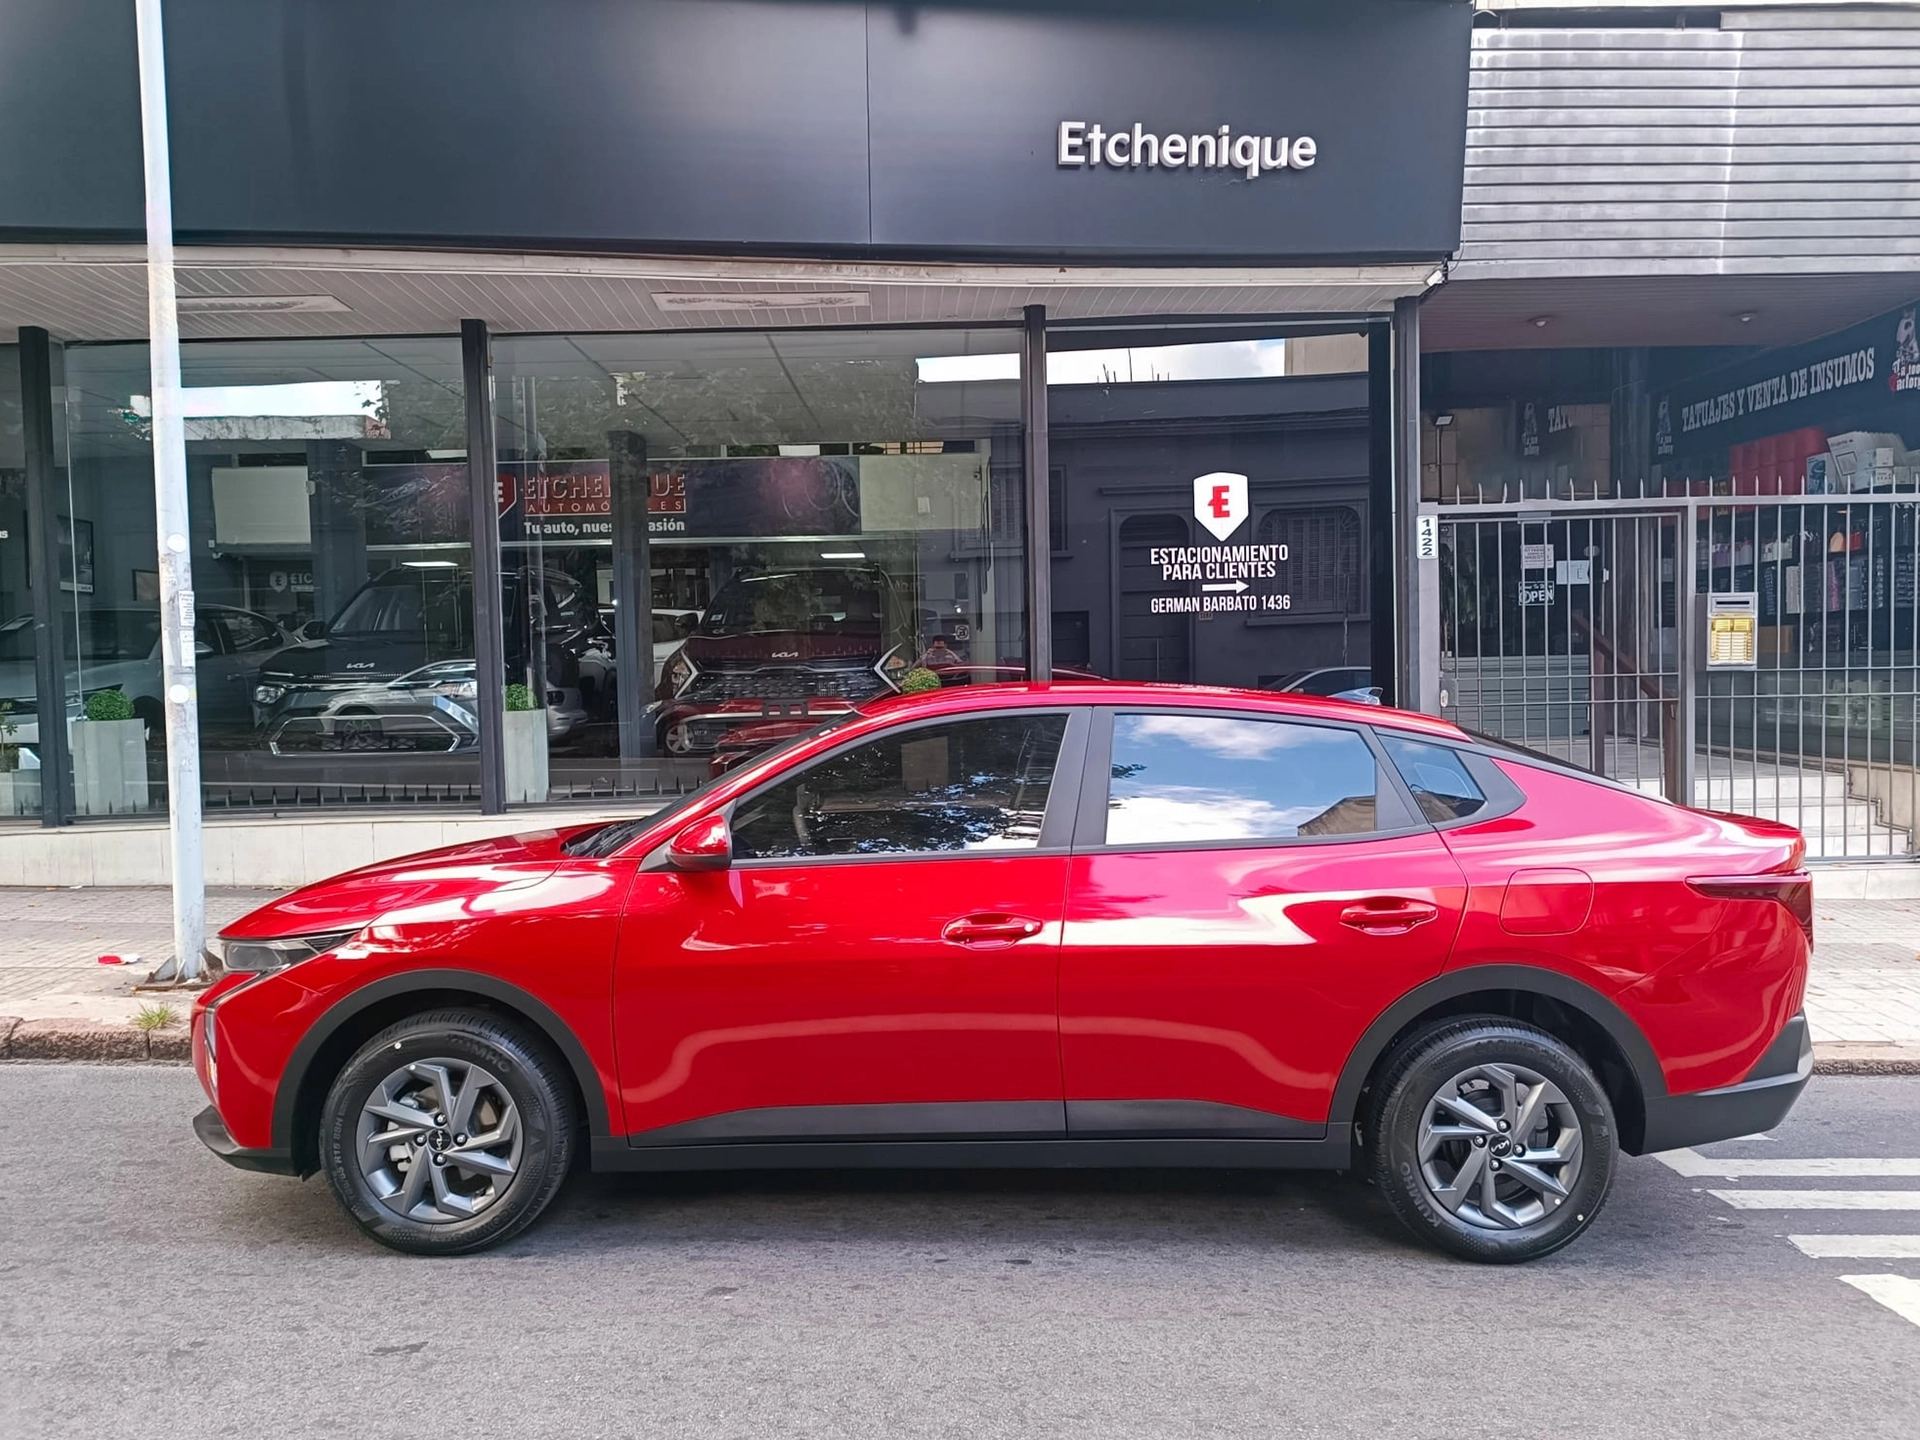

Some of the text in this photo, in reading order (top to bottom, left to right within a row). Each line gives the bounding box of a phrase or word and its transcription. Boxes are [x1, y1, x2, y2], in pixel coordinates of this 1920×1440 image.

[1058, 121, 1317, 179] Etchenique
[1681, 347, 1875, 432] TATUAJES Y VENTA DE INSUMOS
[524, 521, 540, 534] Tu
[544, 521, 580, 536] auto,
[1421, 518, 1433, 556] 1422
[1150, 544, 1289, 565] ESTACIONAMIENTO
[1162, 561, 1276, 581] PARA CLIENTES
[1150, 594, 1291, 613] GERMAN BARBATO 1436
[1519, 590, 1554, 604] OPEN
[1400, 1161, 1442, 1228] KUMHO
